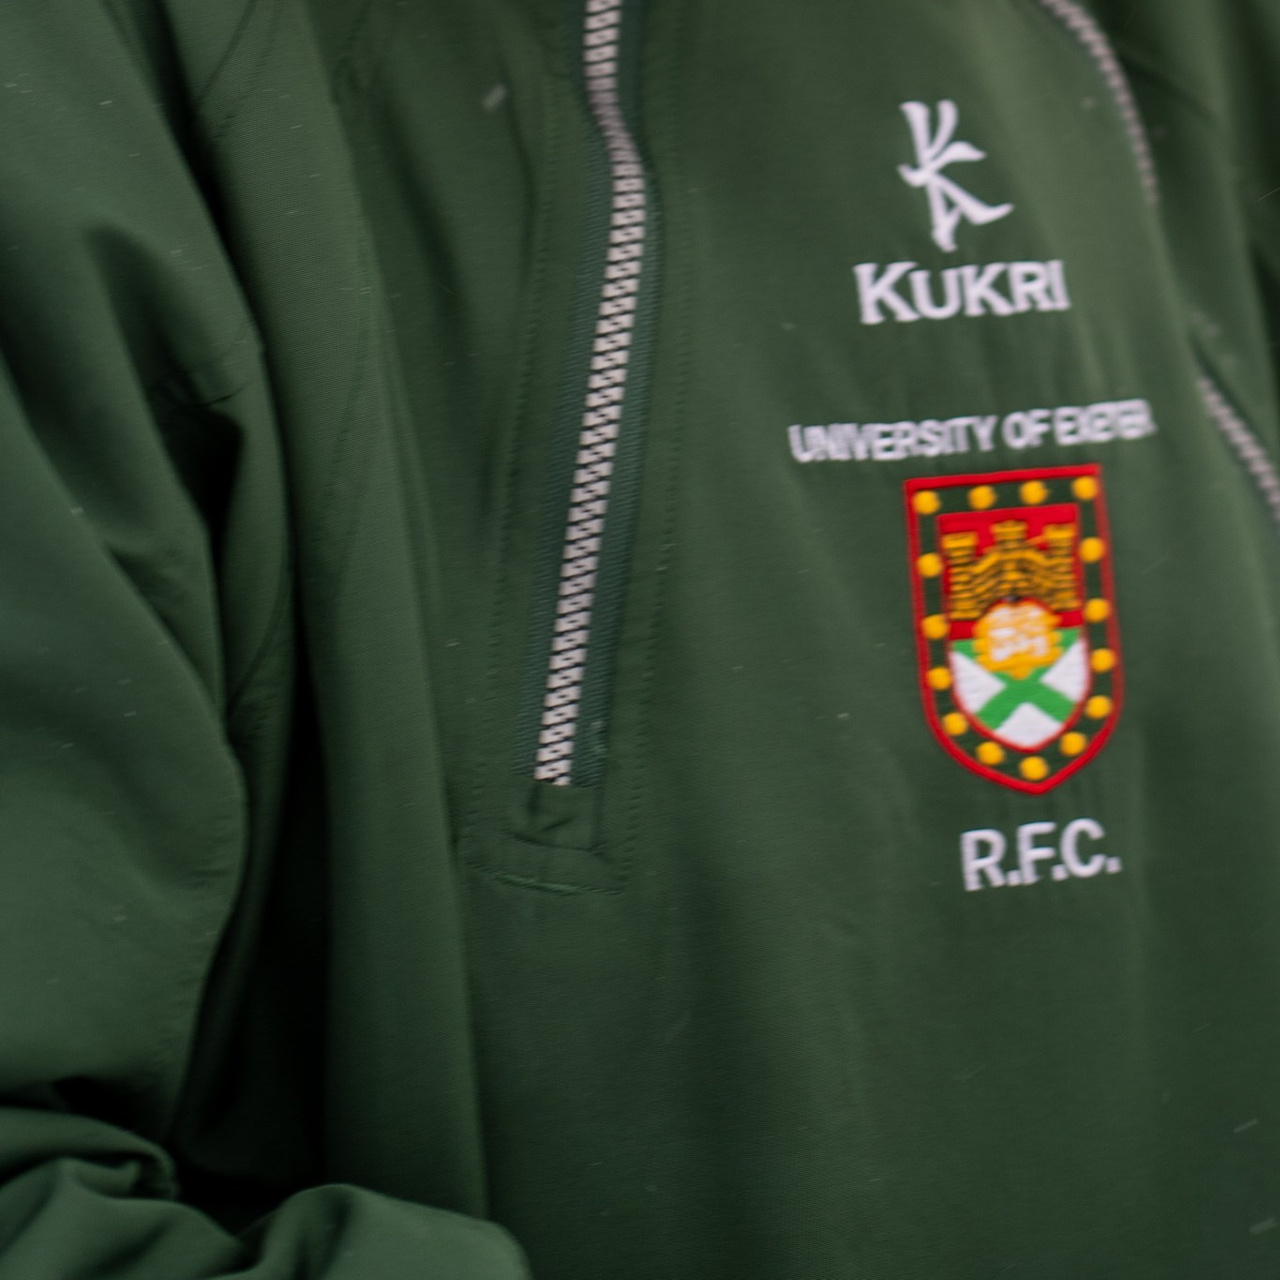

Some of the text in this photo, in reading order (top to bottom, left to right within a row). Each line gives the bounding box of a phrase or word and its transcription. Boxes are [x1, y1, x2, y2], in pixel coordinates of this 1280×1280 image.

[853, 260, 1070, 325] KUKRI
[788, 414, 998, 463] UNIVERSITY
[1002, 409, 1052, 450] OF
[960, 817, 1122, 892] R.F.C.
